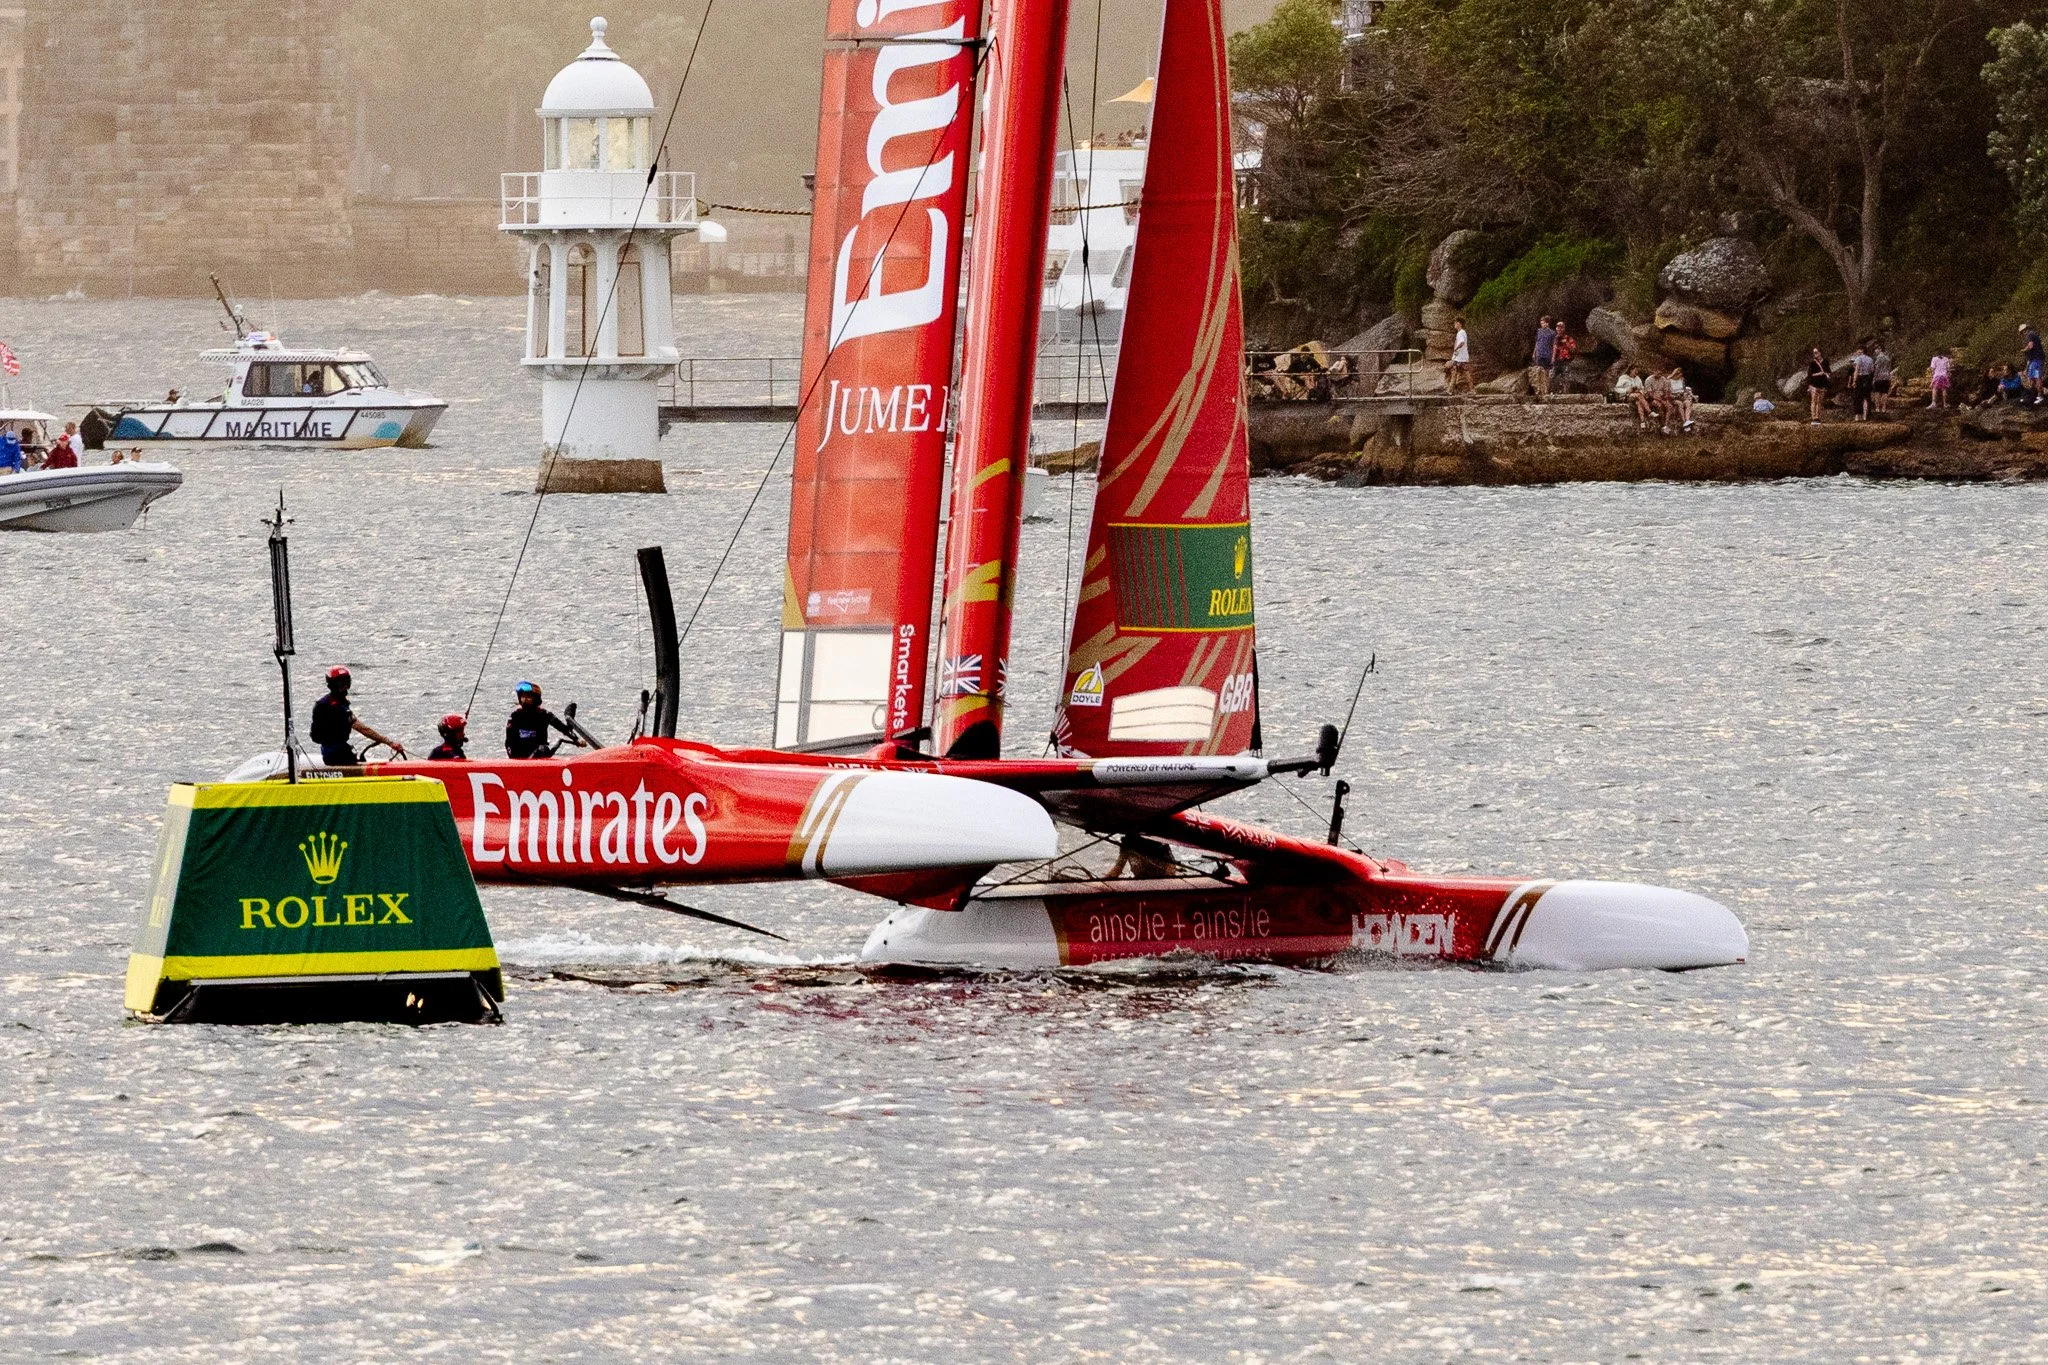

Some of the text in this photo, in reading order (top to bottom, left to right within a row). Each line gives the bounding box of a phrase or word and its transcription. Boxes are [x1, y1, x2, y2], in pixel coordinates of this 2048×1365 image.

[226, 422, 332, 438] MARITIME
[892, 624, 915, 730] Smarkets
[1220, 672, 1254, 713] GBR
[1072, 694, 1101, 704] DOYLE
[1106, 764, 1147, 773] POWERED
[1148, 764, 1159, 772] BY
[467, 768, 708, 865] Emirates
[239, 893, 413, 929] ROLEX
[1090, 901, 1166, 943] ainslie
[1193, 896, 1271, 940] ainslie
[1352, 912, 1456, 956] HOWDEN
